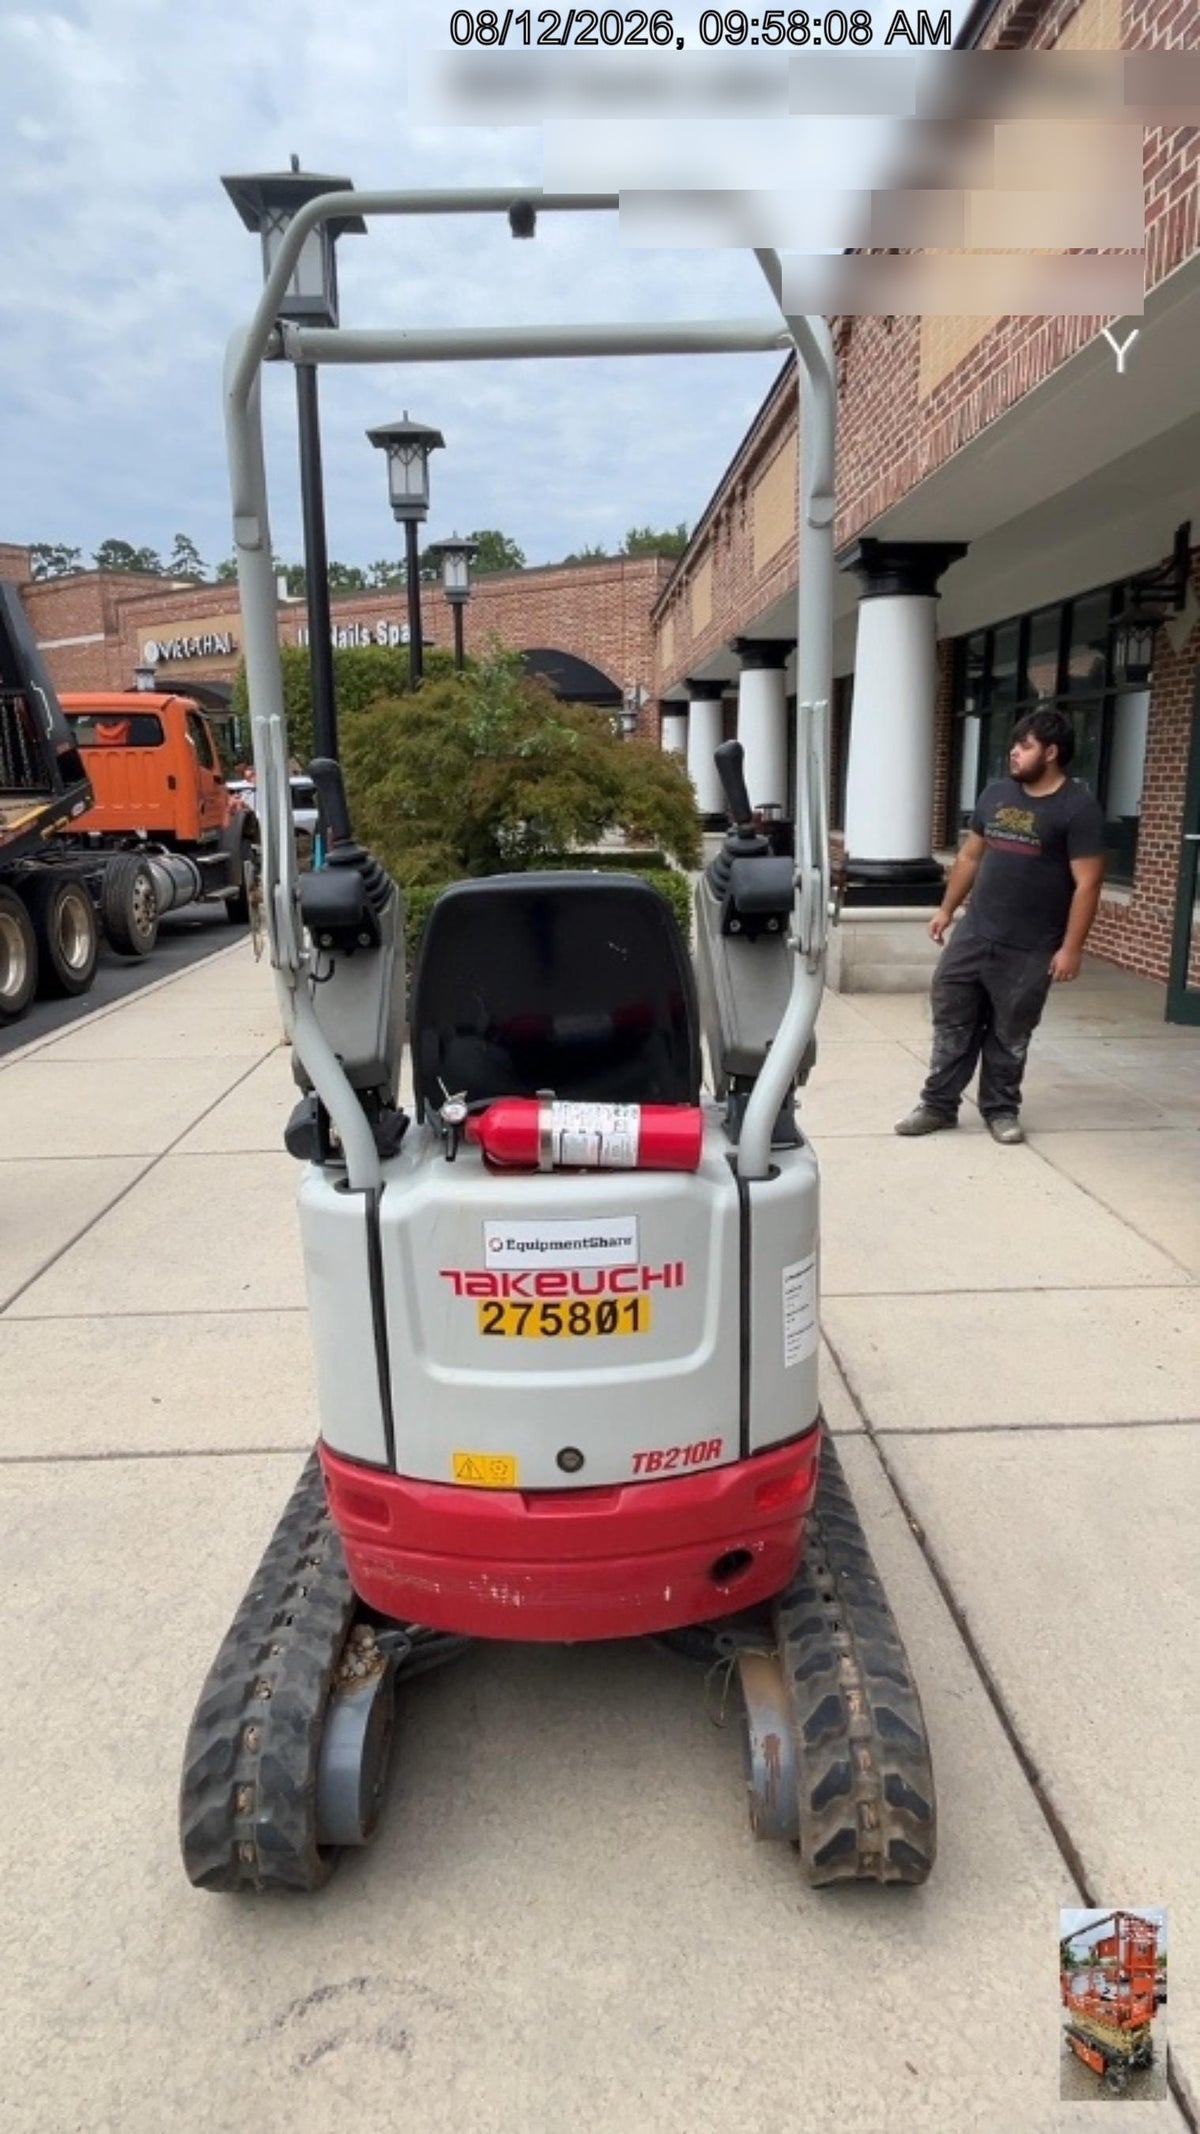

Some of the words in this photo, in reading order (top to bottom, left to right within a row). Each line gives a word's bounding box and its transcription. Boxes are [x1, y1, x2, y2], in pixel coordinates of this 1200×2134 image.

[377, 620, 411, 648] Spa
[506, 1236, 633, 1253] EquipmentShare
[439, 1261, 685, 1298] TAKEUCHI
[481, 1298, 641, 1336] 275801
[632, 1438, 723, 1475] TB210R
